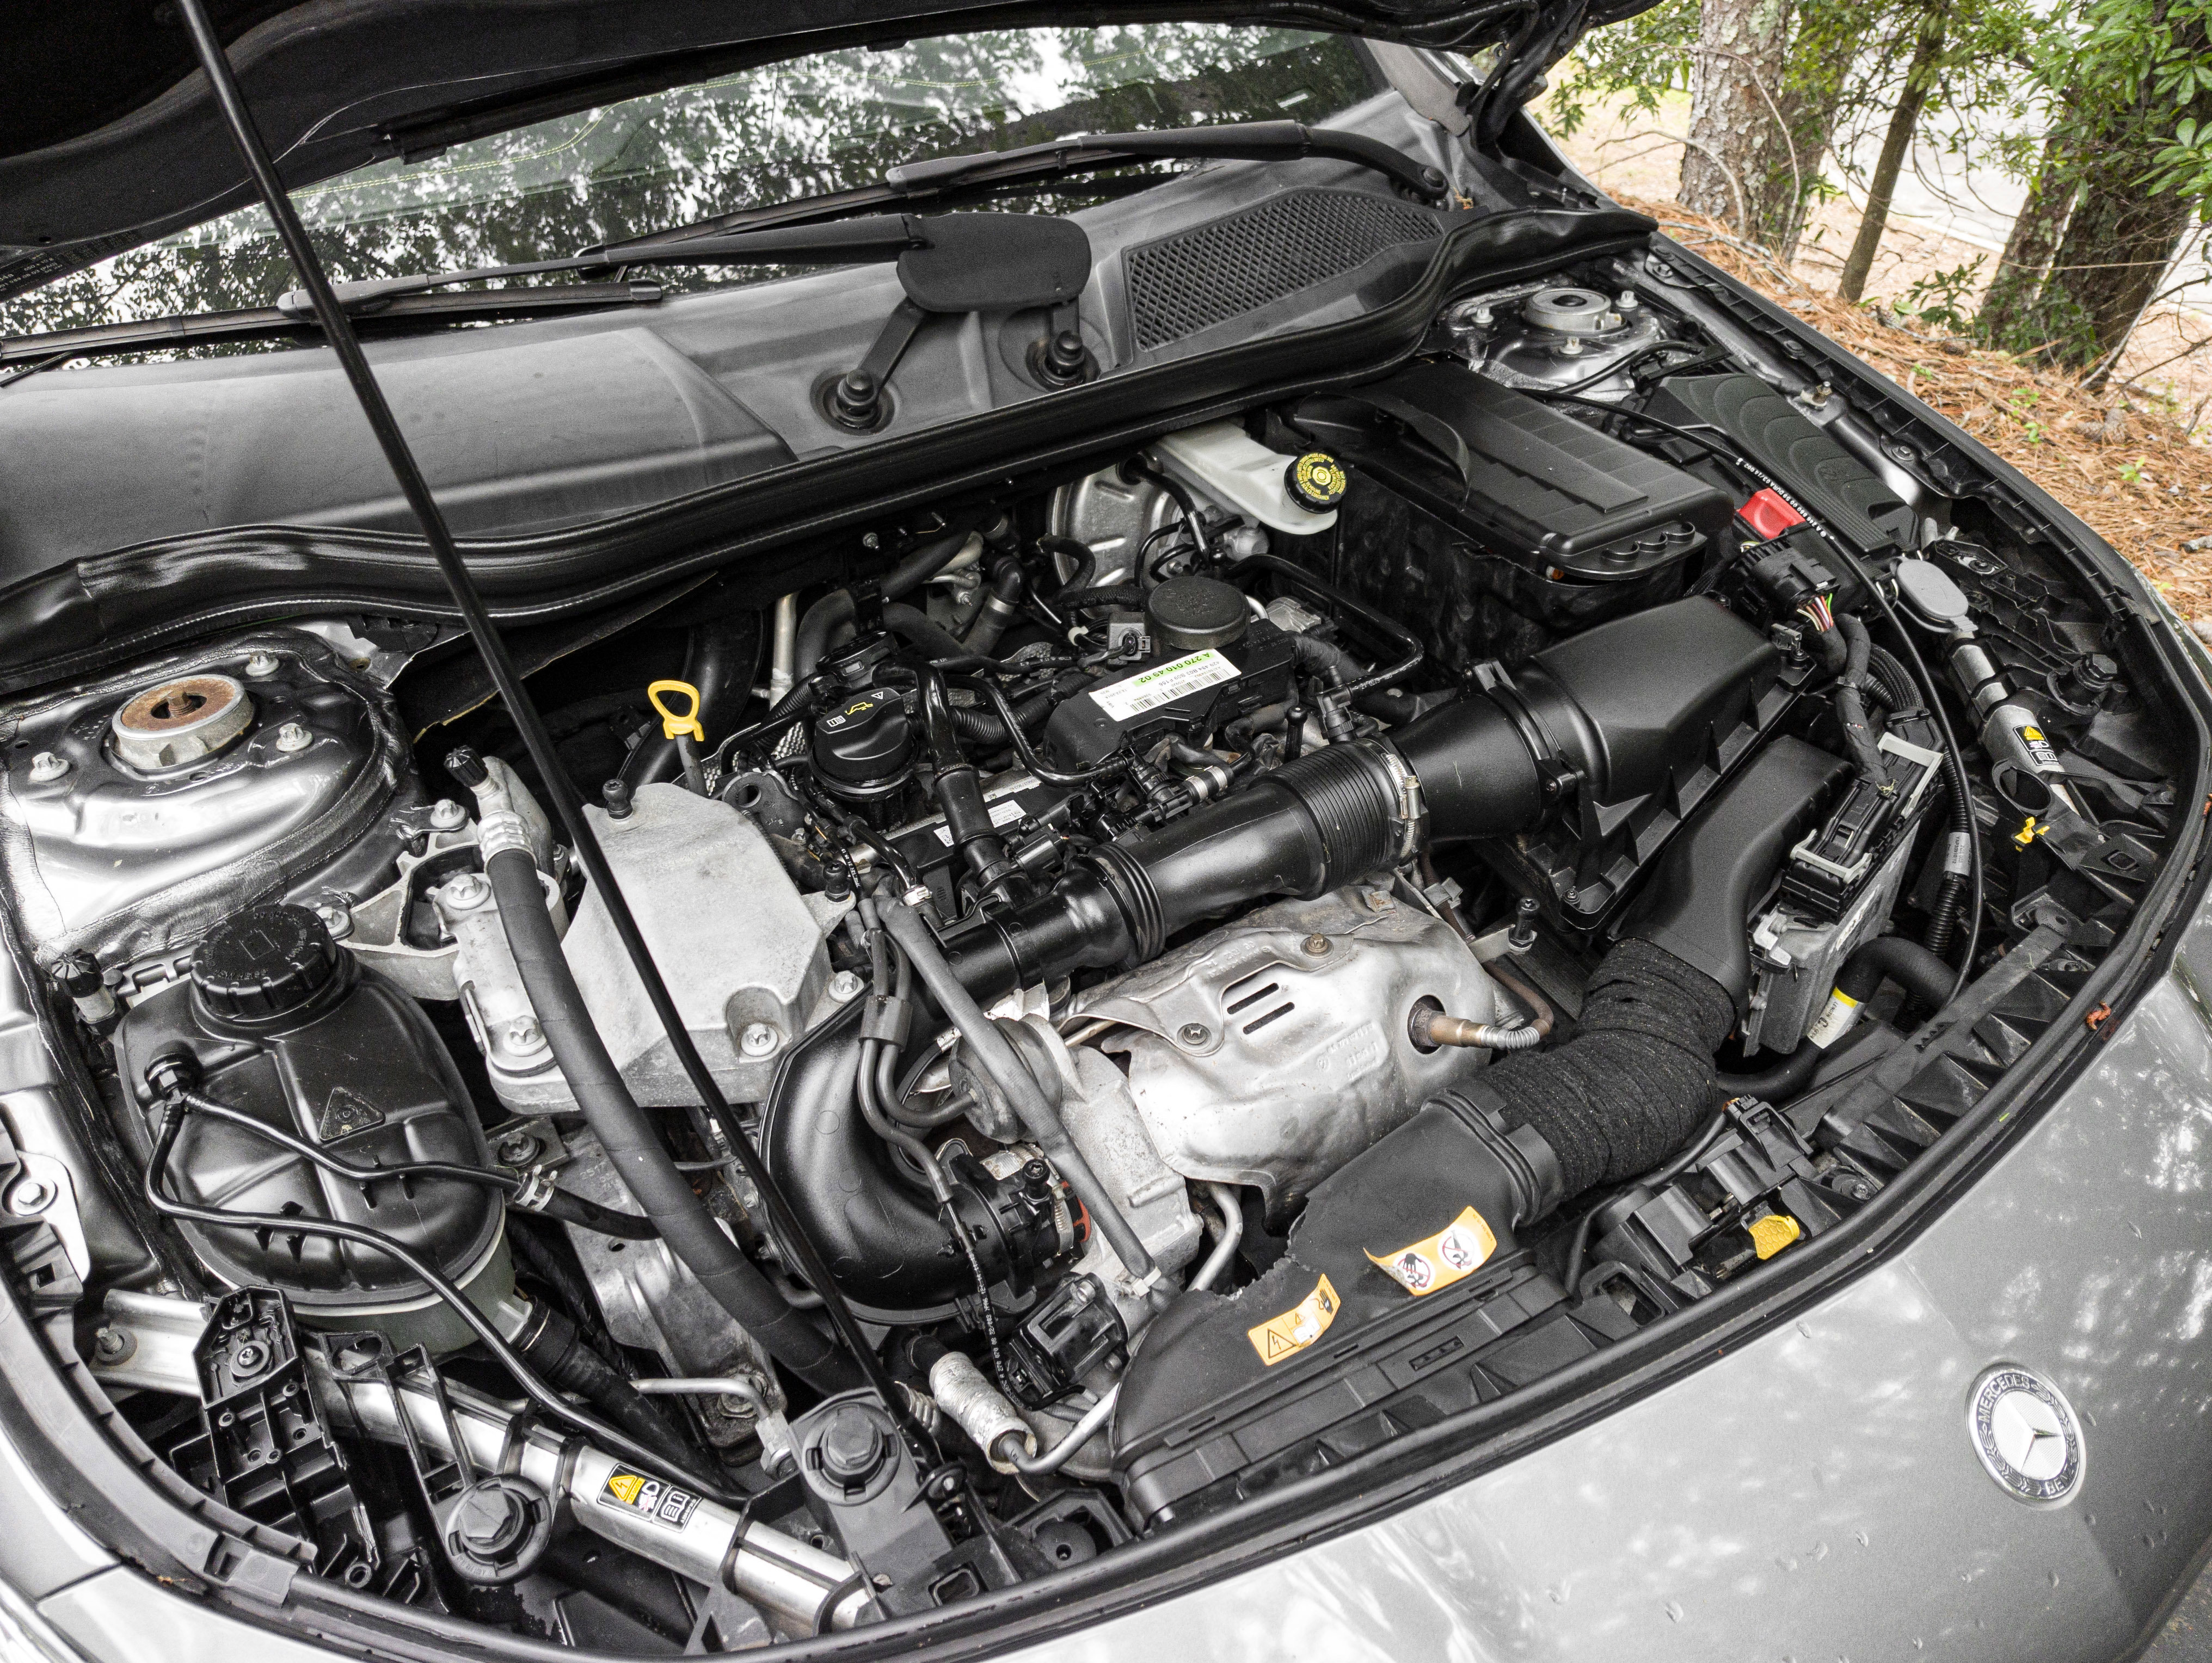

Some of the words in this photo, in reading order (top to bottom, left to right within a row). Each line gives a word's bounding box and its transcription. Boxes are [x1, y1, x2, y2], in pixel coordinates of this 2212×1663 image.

[1768, 479, 1785, 496] DURA
[1184, 655, 1201, 666] 270
[1152, 669, 1164, 678] 49
[1165, 662, 1183, 673] 010
[1138, 674, 1151, 683] 02
[1826, 1001, 1839, 1018] LENGTH
[1817, 1016, 1830, 1028] C
[1978, 1374, 2030, 1422] MERCEDES
[2045, 1463, 2074, 1495] BENZ
